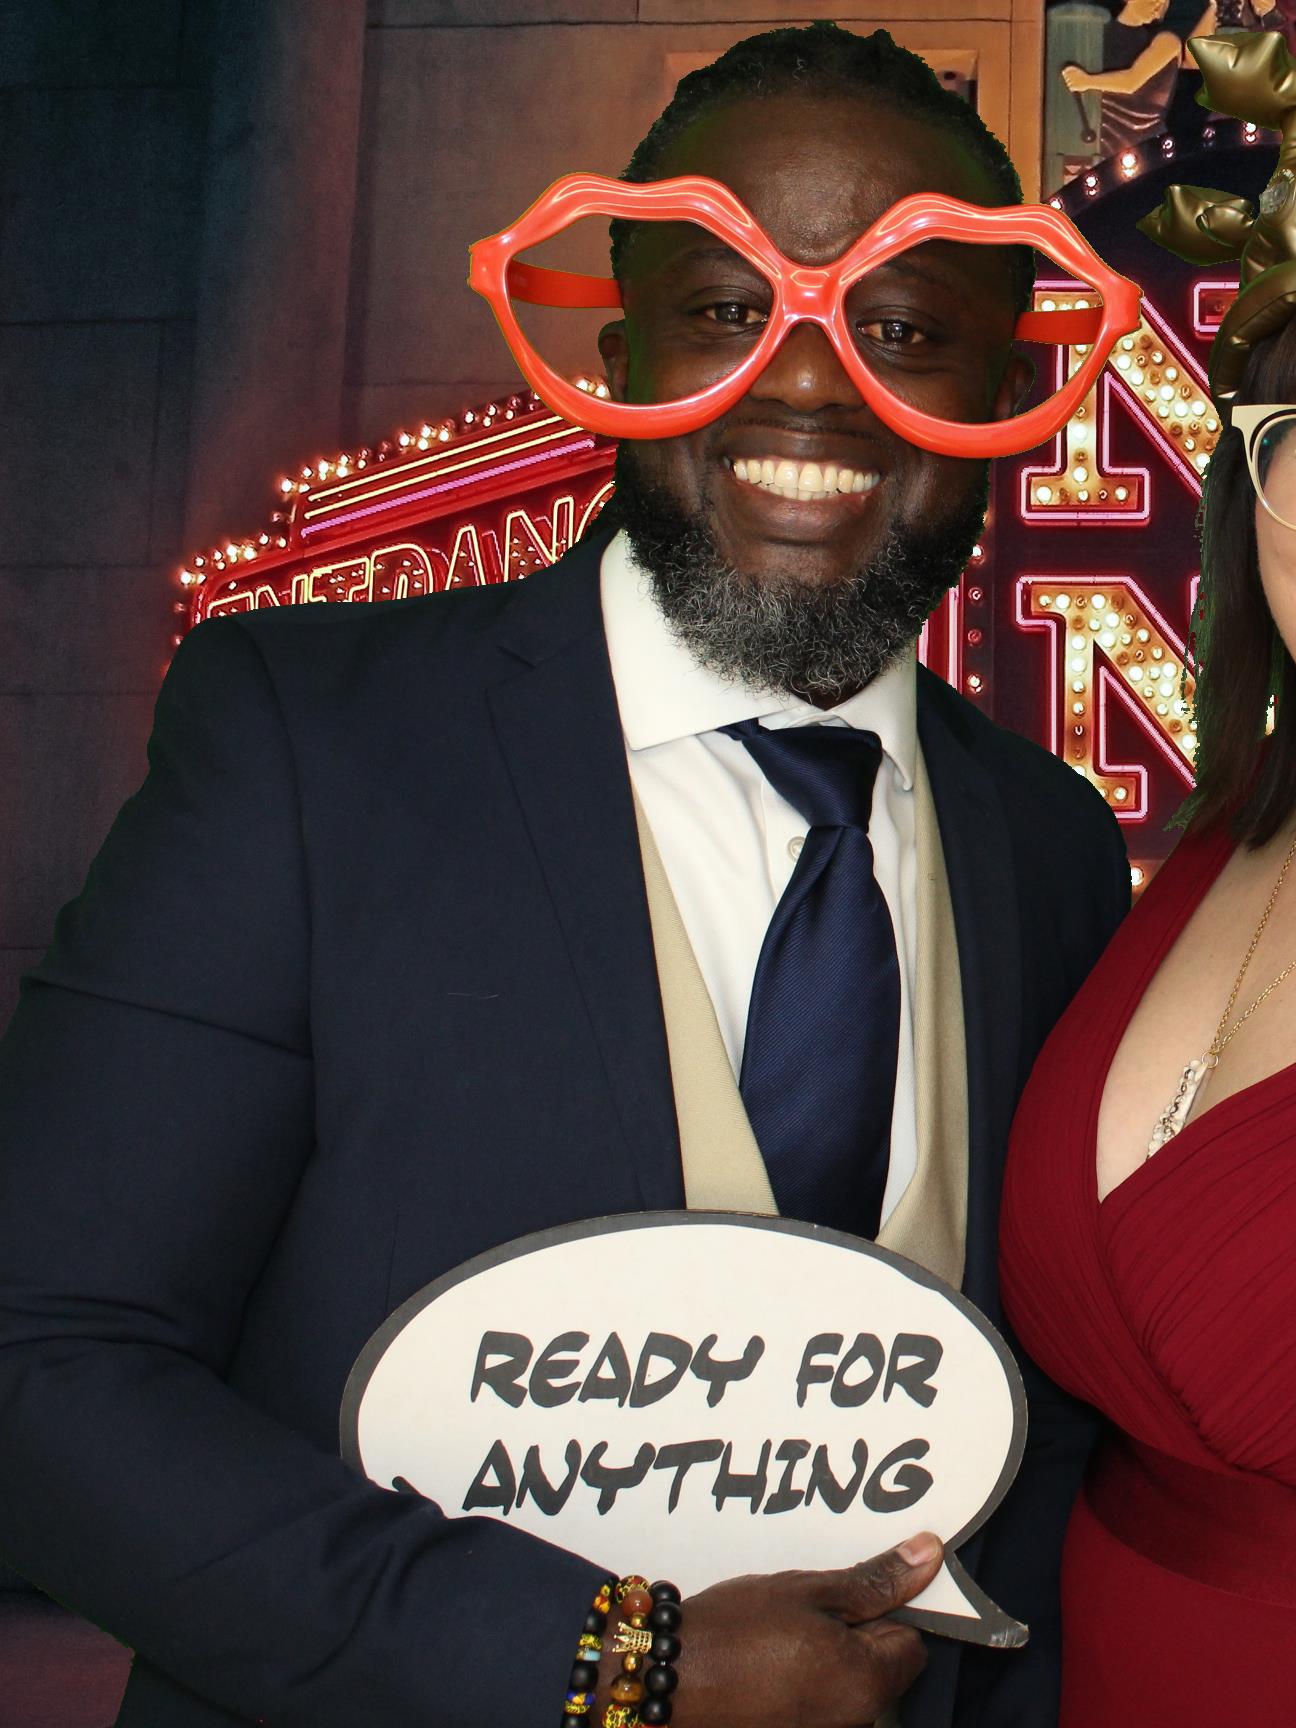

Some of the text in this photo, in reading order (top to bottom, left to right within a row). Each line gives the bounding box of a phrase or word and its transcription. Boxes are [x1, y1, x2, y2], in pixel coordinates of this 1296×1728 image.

[470, 1331, 944, 1408] READY FOR
[461, 1438, 935, 1517] ANYTHING
